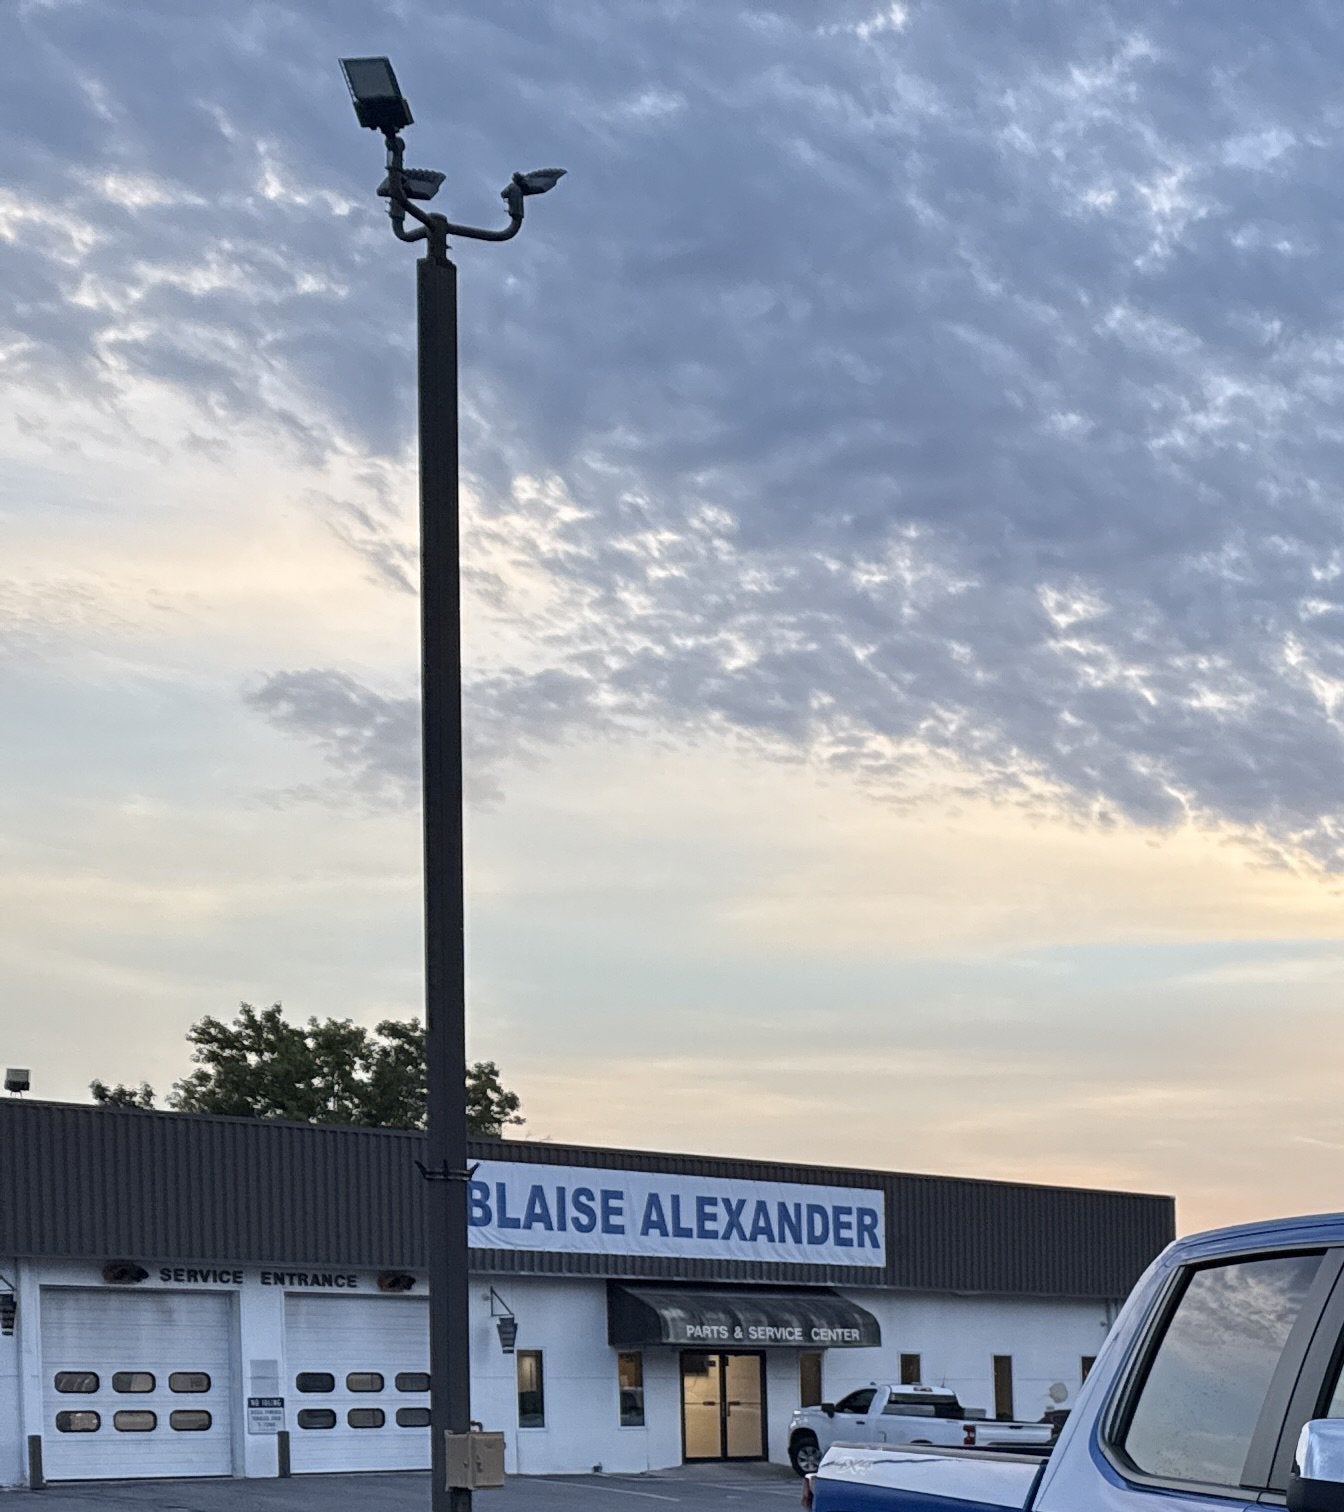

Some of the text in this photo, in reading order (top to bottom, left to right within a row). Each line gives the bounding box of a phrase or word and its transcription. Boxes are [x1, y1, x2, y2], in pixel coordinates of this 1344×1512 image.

[467, 1179, 881, 1249] BLAISE ALEXANDER
[159, 1267, 359, 1288] SERVICE ENTRANCE
[686, 1324, 861, 1341] PARTS & SERVICE CENTER
